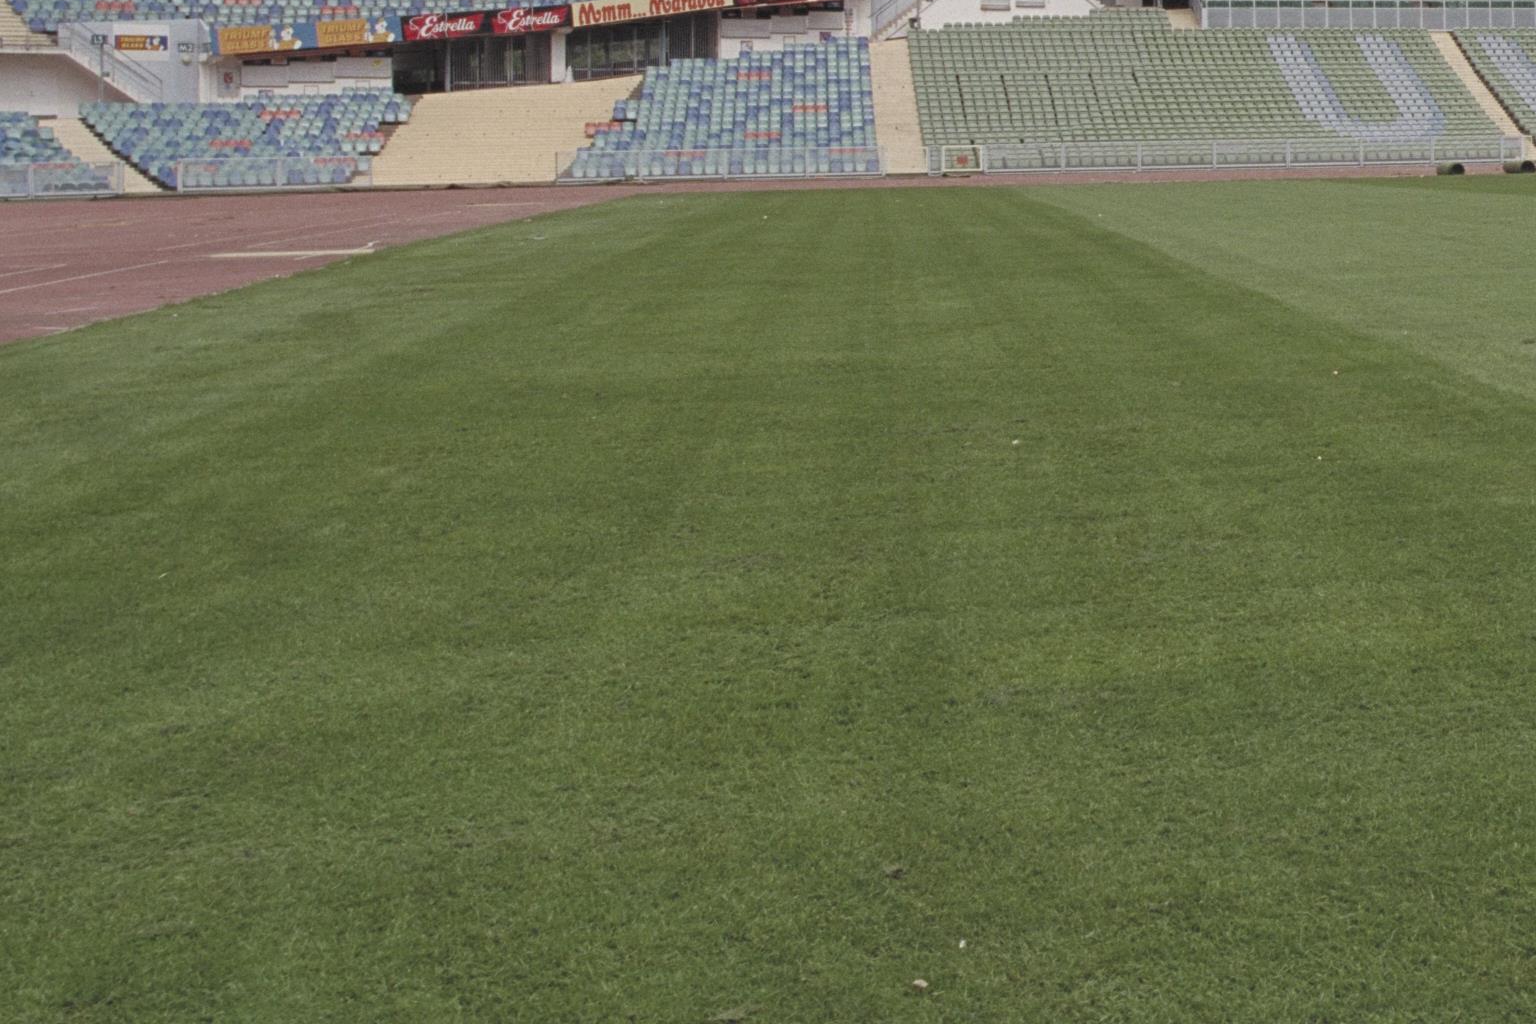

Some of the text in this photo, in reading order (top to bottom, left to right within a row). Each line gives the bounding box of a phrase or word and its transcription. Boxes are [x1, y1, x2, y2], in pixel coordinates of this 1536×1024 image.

[509, 8, 560, 31] Estrella
[578, 2, 646, 26] Mmm...
[420, 15, 476, 38] Estrella
